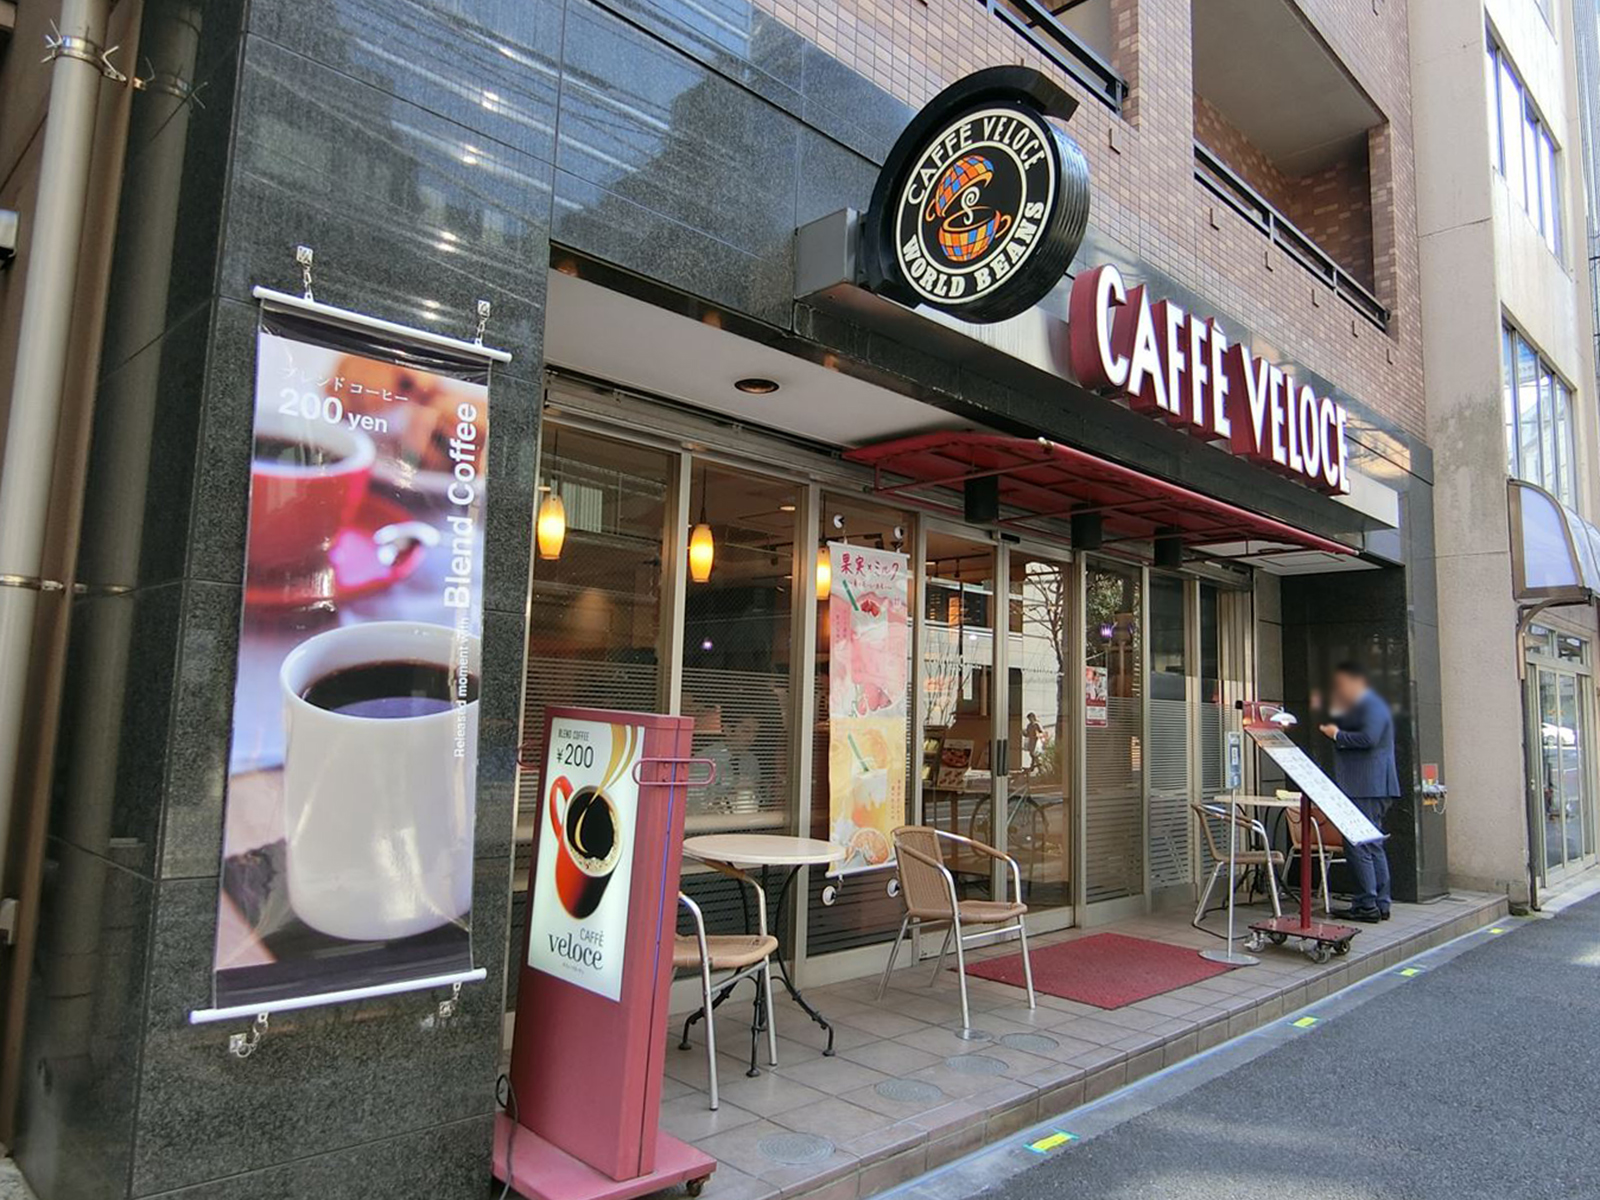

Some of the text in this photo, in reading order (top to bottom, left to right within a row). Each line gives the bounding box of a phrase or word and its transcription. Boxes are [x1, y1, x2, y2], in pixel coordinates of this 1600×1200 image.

[983, 115, 1046, 171] VELOCE
[902, 201, 1045, 297] WORLD BEANS
[277, 387, 389, 434] 200 yen
[350, 382, 409, 403] コーヒー
[1240, 343, 1350, 494] VELOCE
[447, 402, 479, 507] Coffee
[443, 515, 474, 609] Blend
[457, 646, 470, 698] moment
[557, 743, 594, 769] ¥200
[573, 730, 590, 741] COFFEE
[548, 932, 604, 970] veloce
